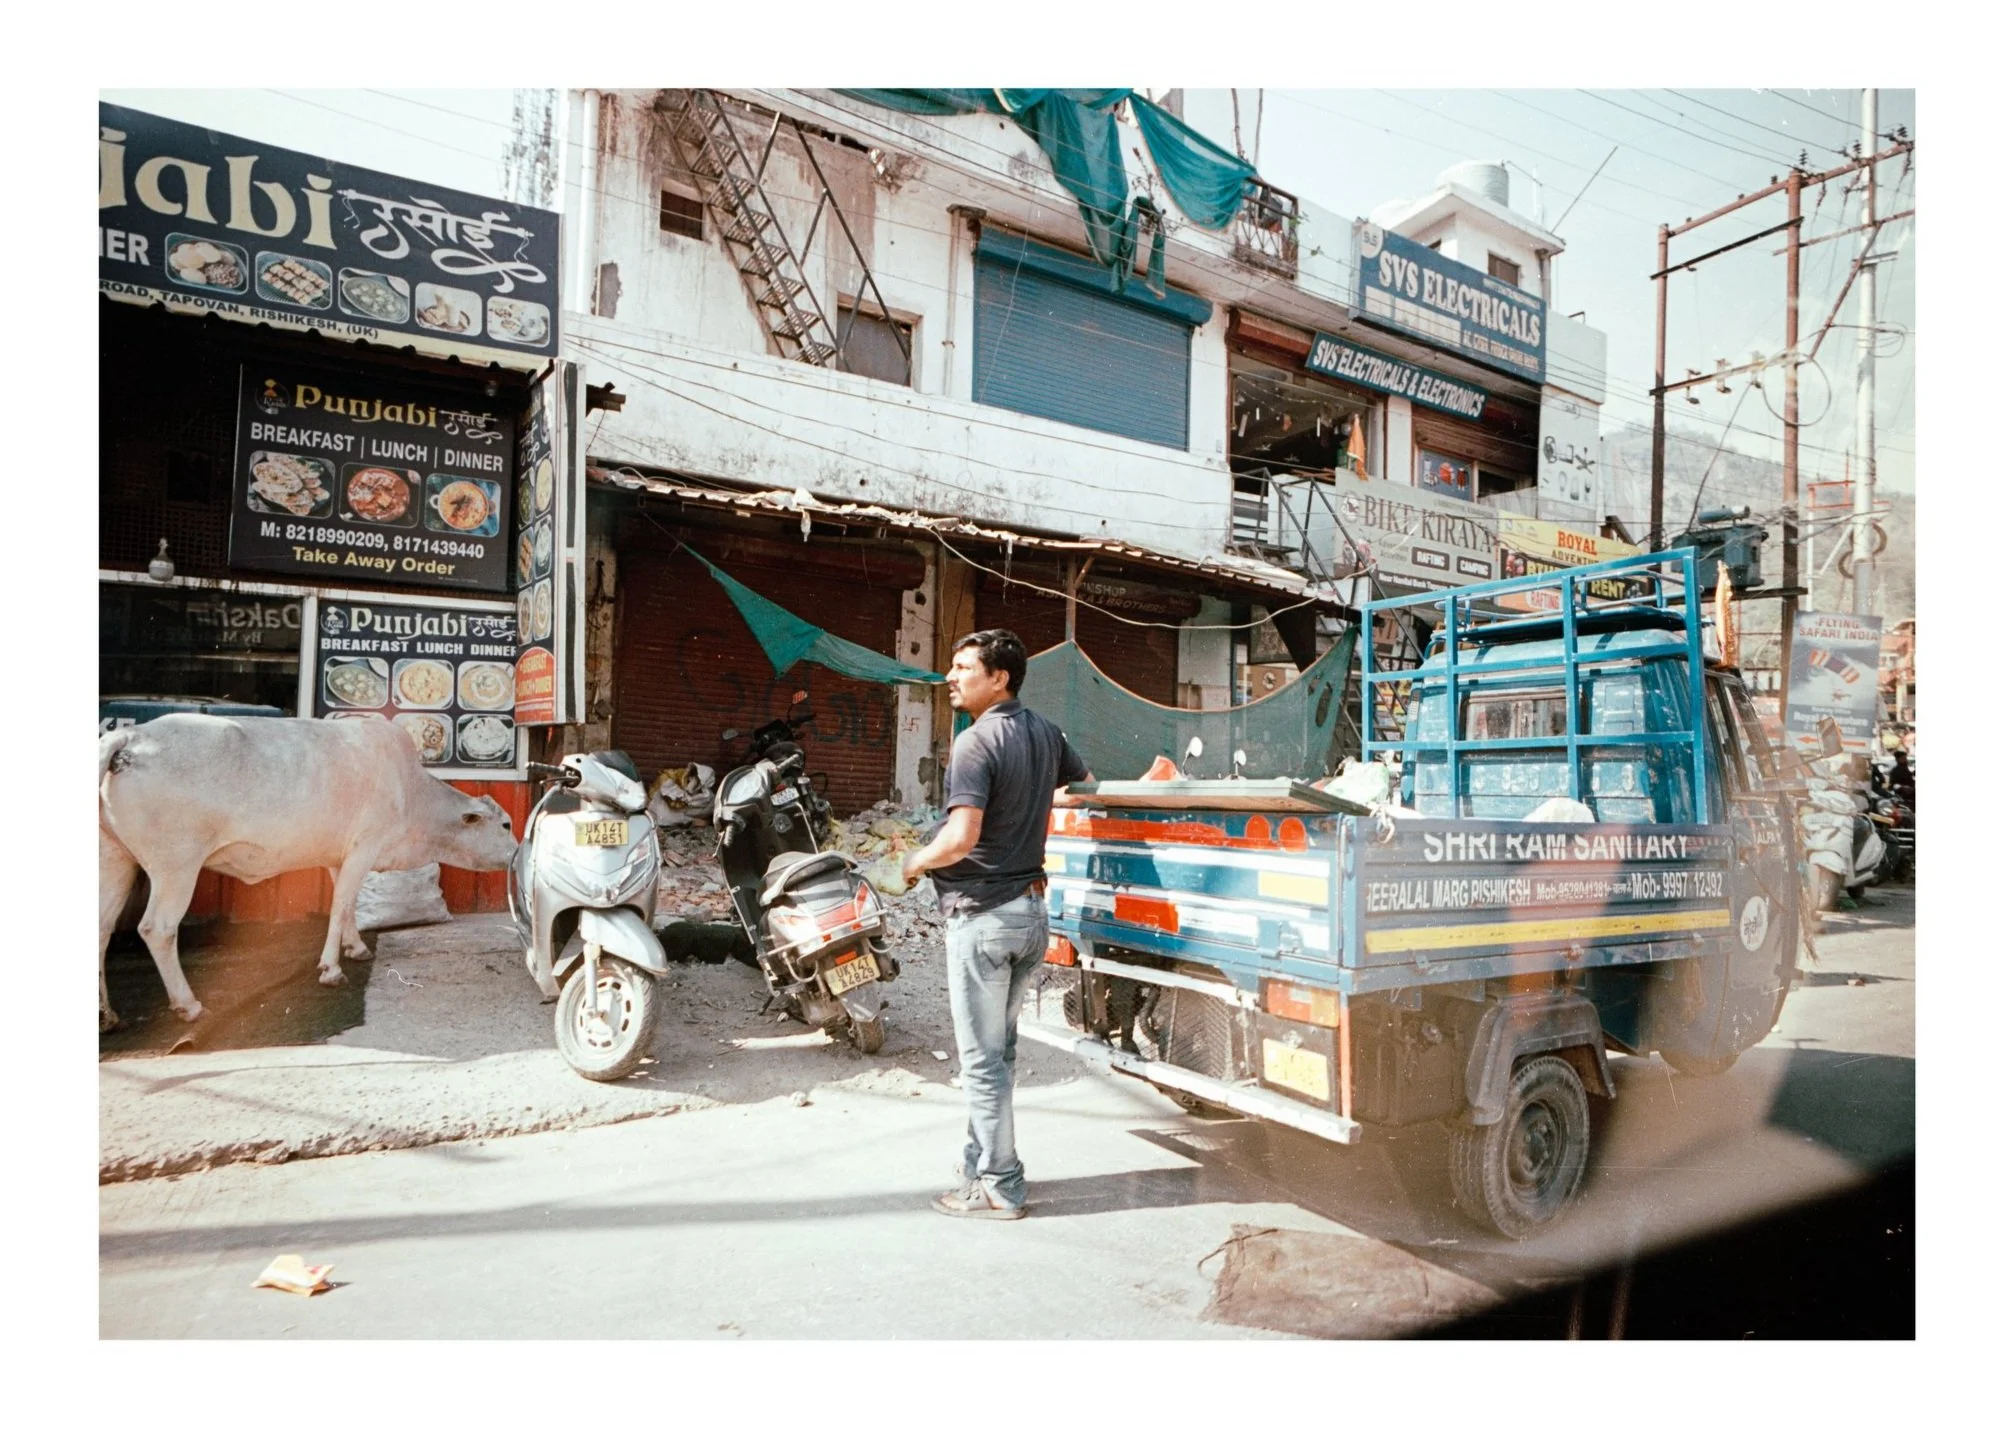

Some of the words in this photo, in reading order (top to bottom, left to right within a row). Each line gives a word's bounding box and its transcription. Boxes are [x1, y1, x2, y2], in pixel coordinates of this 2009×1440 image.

[100, 280, 153, 300] ROAD,
[159, 290, 244, 316] TAPOVAN,
[250, 307, 342, 334] RISHIKESH,
[347, 324, 379, 340] (UK)
[1379, 251, 1419, 298] SVS
[1423, 268, 1540, 347] ELECTRICALS
[1313, 340, 1339, 370] SVS
[1336, 347, 1410, 393] ELECTRICALS
[1407, 372, 1420, 396] &
[1417, 376, 1485, 417] ELECTRONICS
[295, 384, 436, 428] Punjabi
[251, 422, 354, 452] BREAKFAST
[372, 439, 427, 462] LUNCH
[445, 449, 503, 472] DINNER
[1364, 495, 1414, 536] BIKE
[1422, 509, 1492, 553] KIRAYA
[260, 522, 280, 538] M:
[286, 523, 389, 550] 8218990209,
[394, 536, 484, 559] 8171439440
[1557, 530, 1598, 556] ROYAL
[292, 546, 338, 565] Take
[344, 552, 396, 573] Away
[402, 557, 455, 576] Order
[1417, 550, 1445, 567] RAFTING
[1591, 579, 1626, 600] RENT
[350, 607, 468, 640] Punjabi
[1799, 627, 1841, 639] SAFARI
[1845, 630, 1878, 641] INDIA
[1817, 617, 1859, 629] FLYING
[321, 638, 409, 652] BREAKFAST
[417, 642, 463, 655] LUNCH
[1424, 832, 1496, 862] SHRI
[1505, 832, 1566, 861] RAM
[1574, 834, 1688, 860] SANITARY
[1432, 879, 1469, 908] MARG
